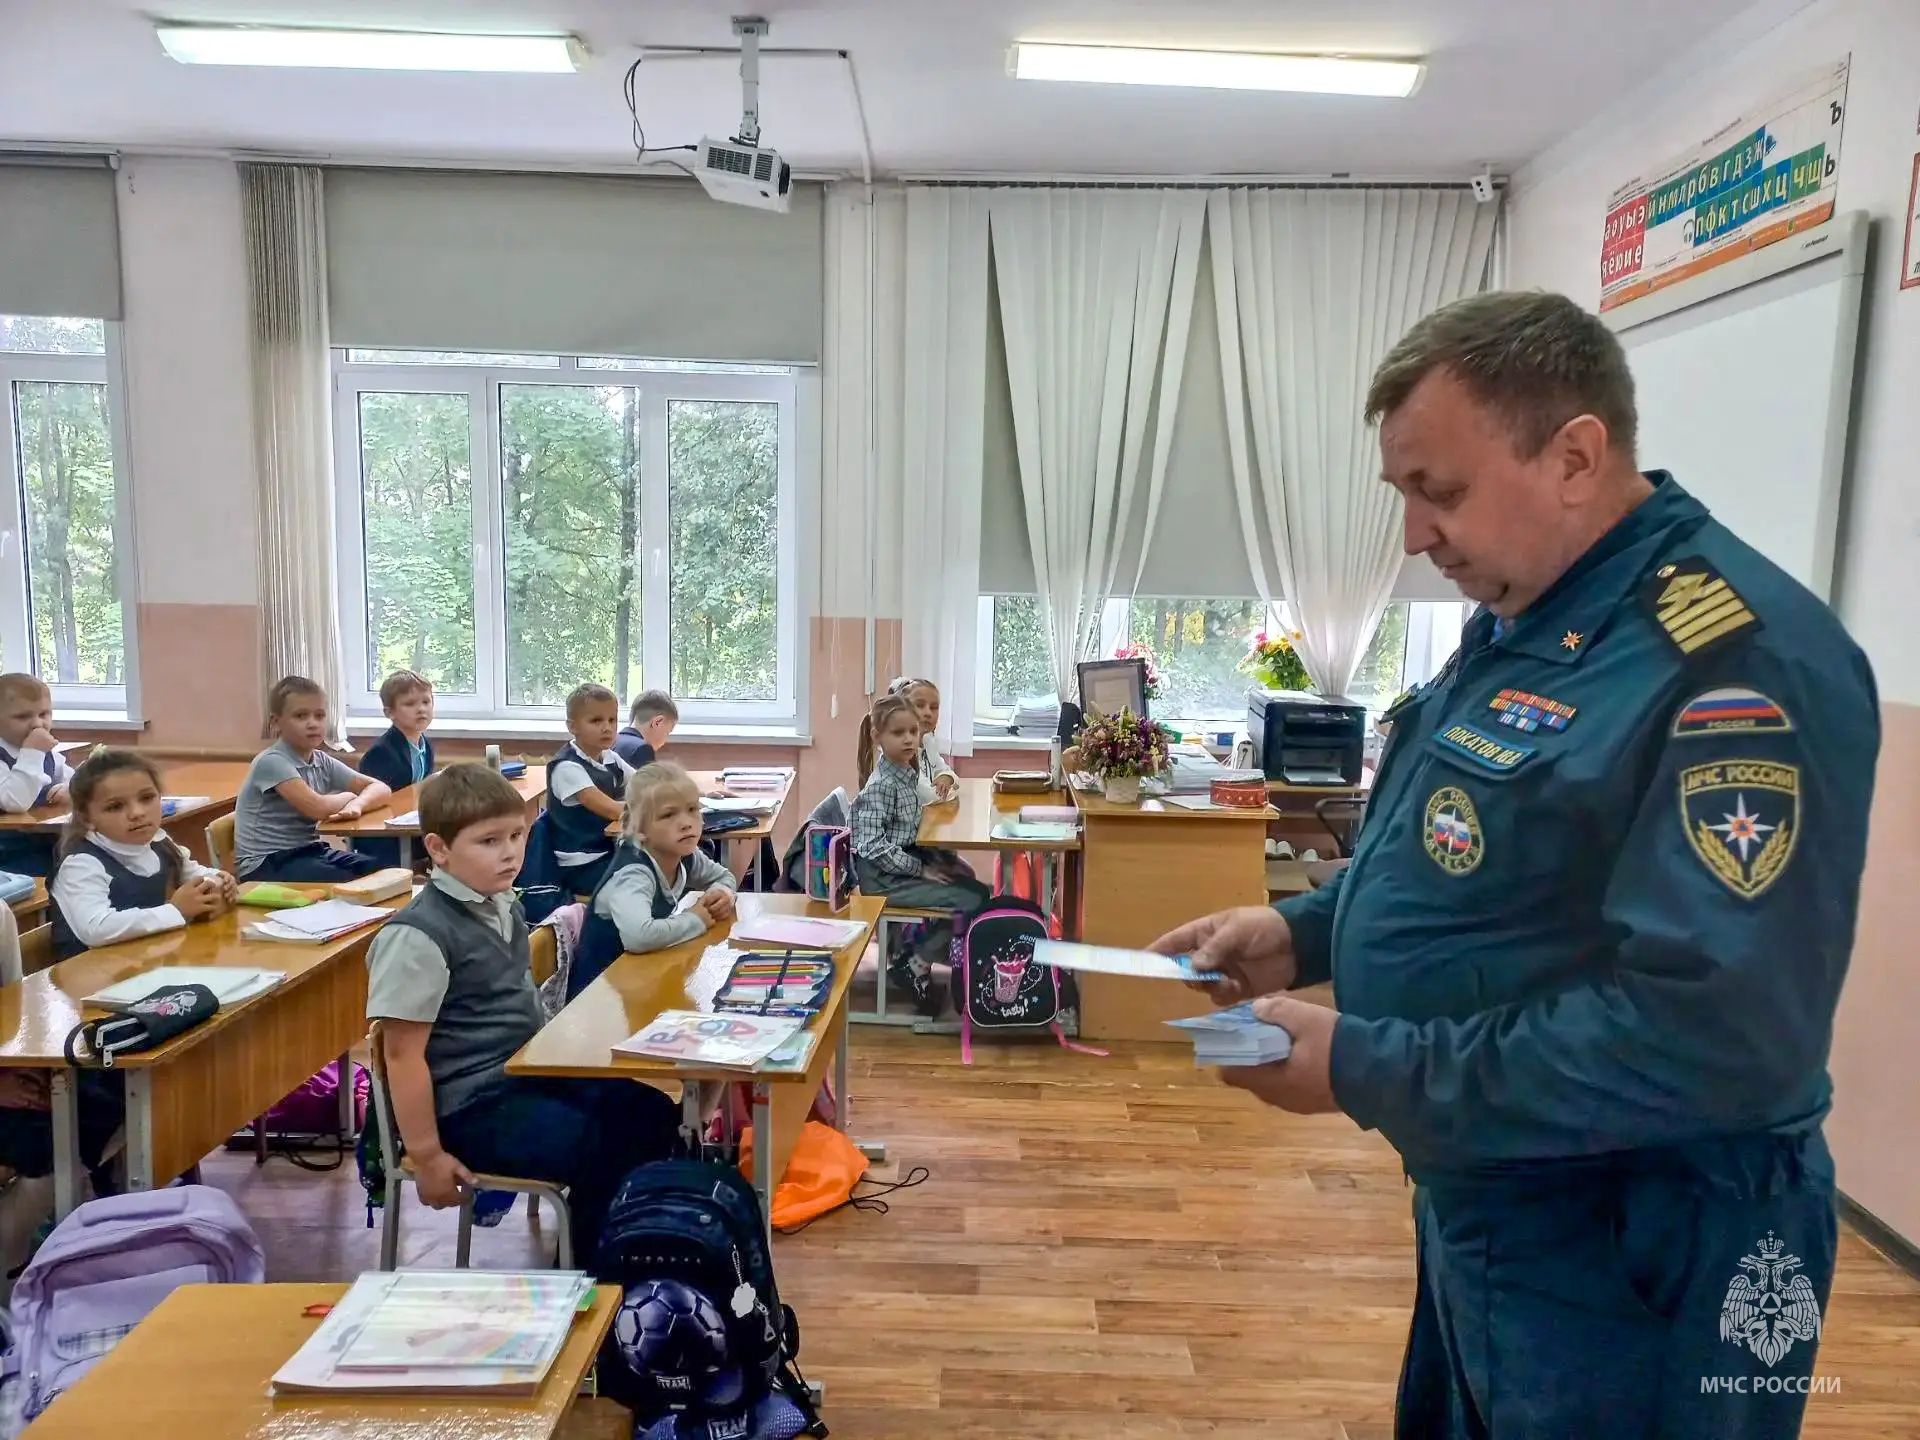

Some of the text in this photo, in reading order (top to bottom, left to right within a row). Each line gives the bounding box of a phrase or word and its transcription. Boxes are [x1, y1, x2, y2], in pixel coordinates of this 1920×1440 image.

[1687, 765, 1792, 790] МЧС РОССИИ
[1001, 998, 1029, 1017] tasty!
